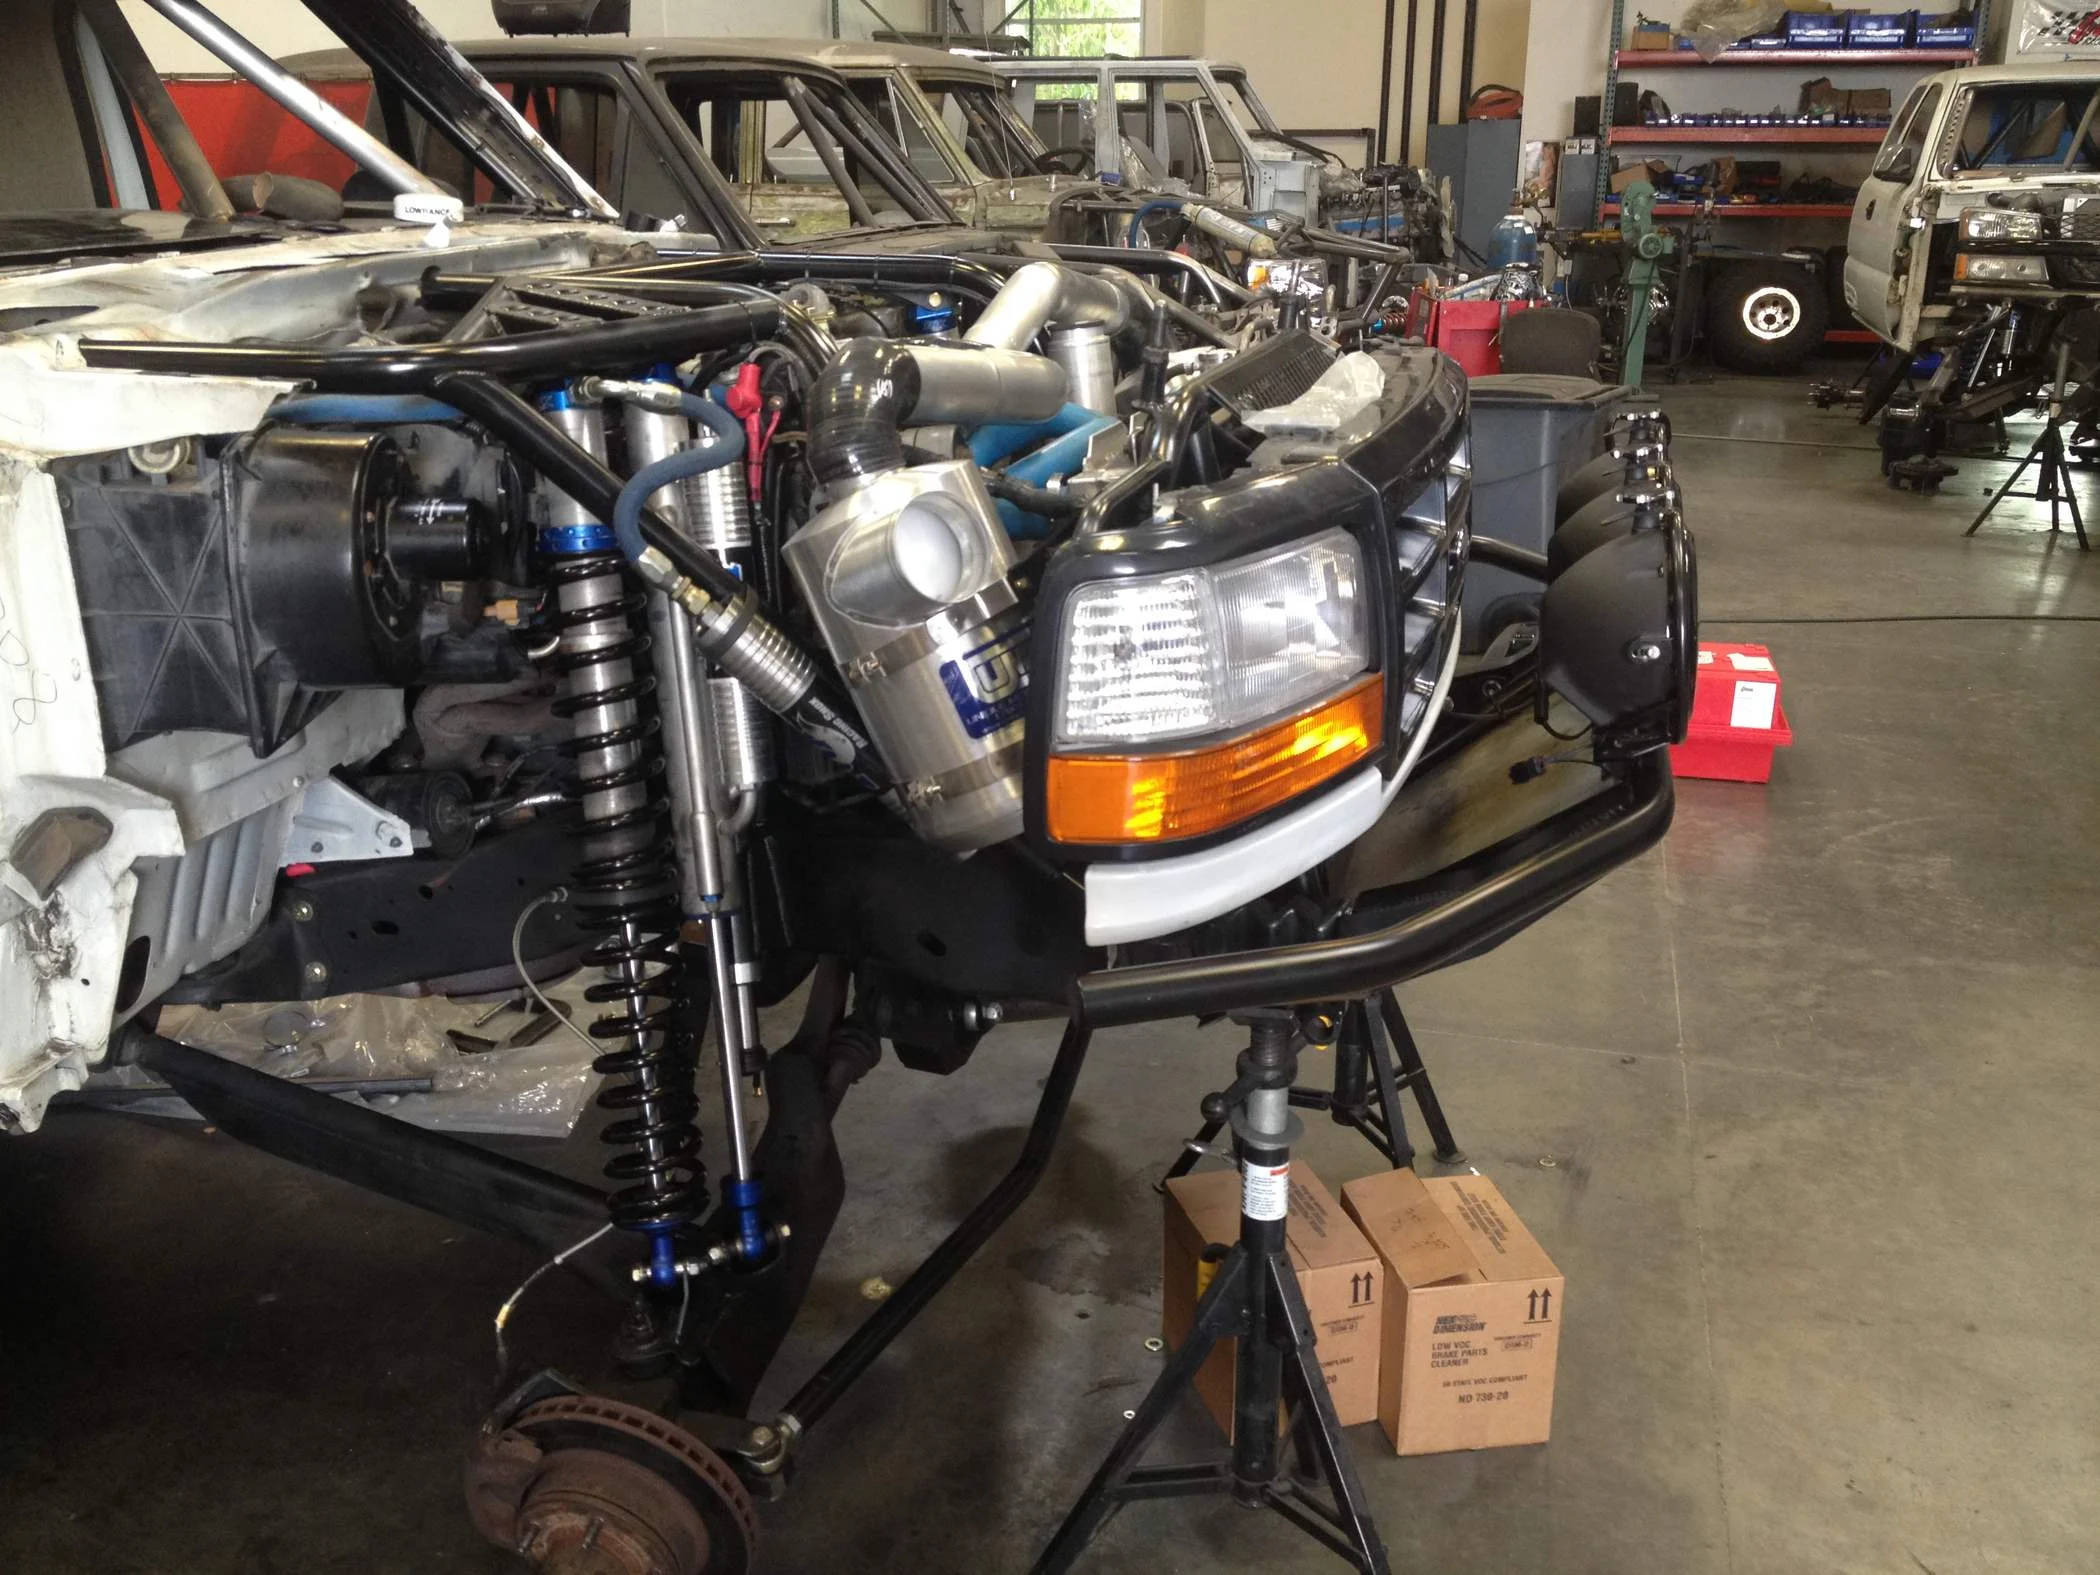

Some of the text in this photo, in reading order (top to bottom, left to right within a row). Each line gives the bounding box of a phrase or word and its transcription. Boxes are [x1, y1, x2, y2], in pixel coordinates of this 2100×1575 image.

[1432, 1340, 1471, 1351] LOW VOC
[1432, 1347, 1488, 1359] BRAKE PARTS
[1431, 1358, 1469, 1368] CLEANER
